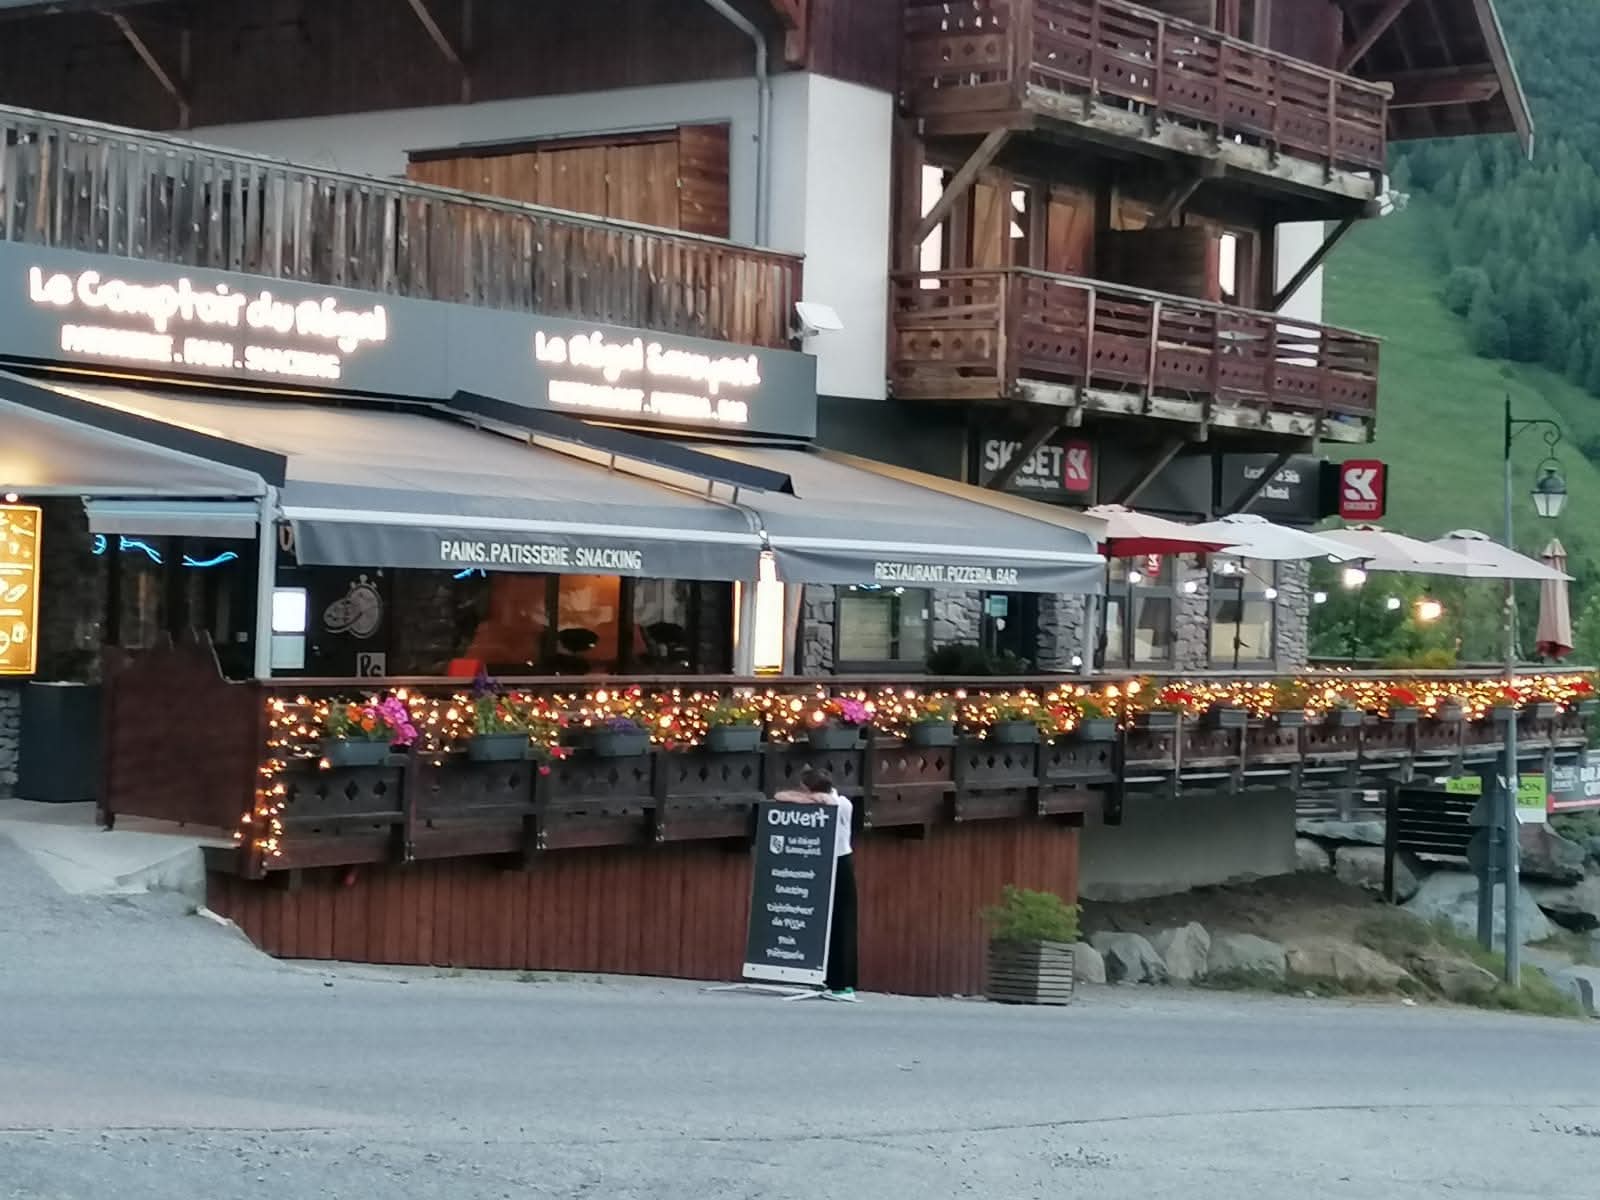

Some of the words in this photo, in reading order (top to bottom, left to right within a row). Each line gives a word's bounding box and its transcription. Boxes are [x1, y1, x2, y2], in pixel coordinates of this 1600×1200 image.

[30, 266, 73, 304] Le
[78, 270, 246, 332] Comptoir
[984, 439, 1064, 477] SKSET
[768, 808, 829, 827] Ouvert
